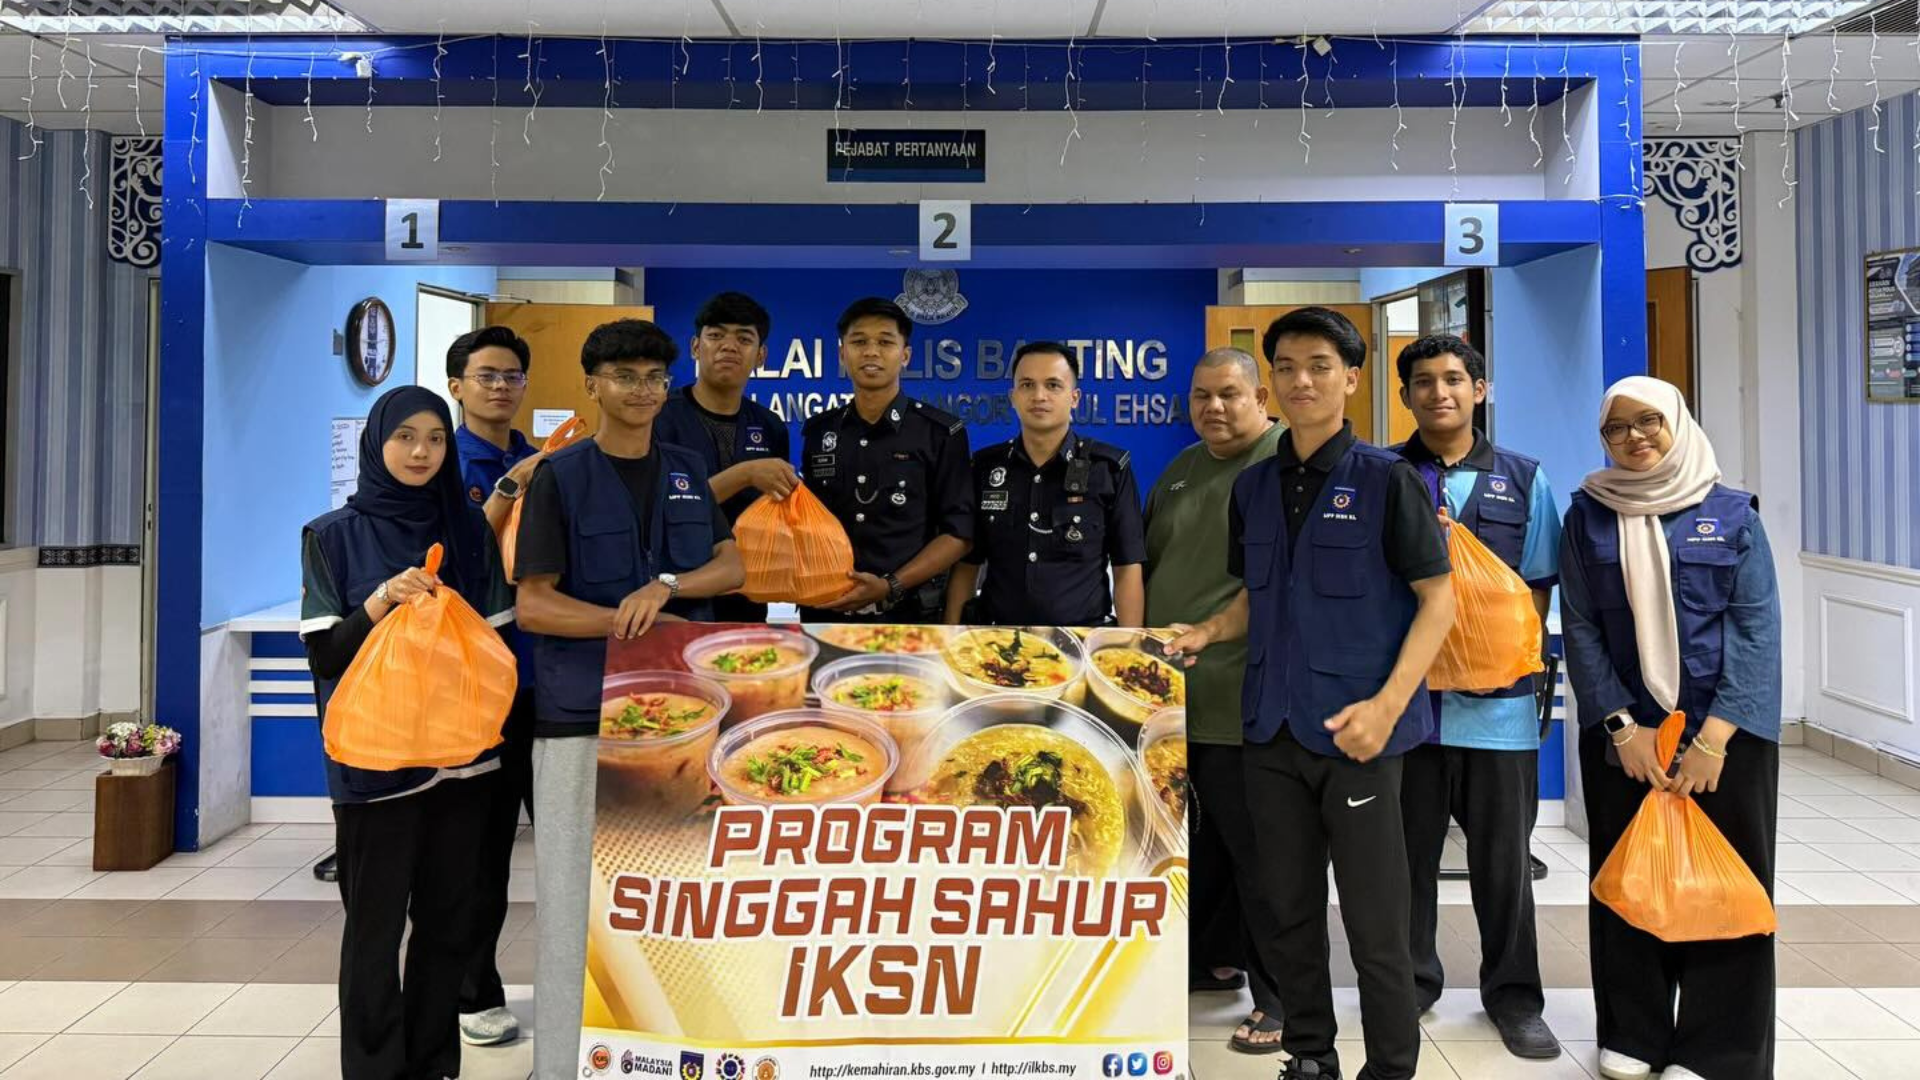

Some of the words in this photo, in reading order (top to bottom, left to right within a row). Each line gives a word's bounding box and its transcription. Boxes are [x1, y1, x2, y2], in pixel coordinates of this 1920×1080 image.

[835, 142, 890, 156] PEJABAT
[895, 142, 976, 157] PERTANYAAN
[401, 212, 424, 248] 1
[932, 212, 957, 248] 2
[1459, 216, 1484, 254] 3
[1115, 393, 1189, 424] EHSA
[709, 806, 1069, 869] PROGRAM
[607, 873, 918, 940] SINGGAH
[929, 875, 1169, 939] SAHUR
[779, 943, 983, 1018] IKSN
[634, 1063, 673, 1076] MADANI
[635, 1055, 673, 1067] MALAYSIA
[809, 1061, 976, 1080] http://kemahiran.kbs.gov.my
[991, 1060, 1077, 1077] http://ilkbs.my
